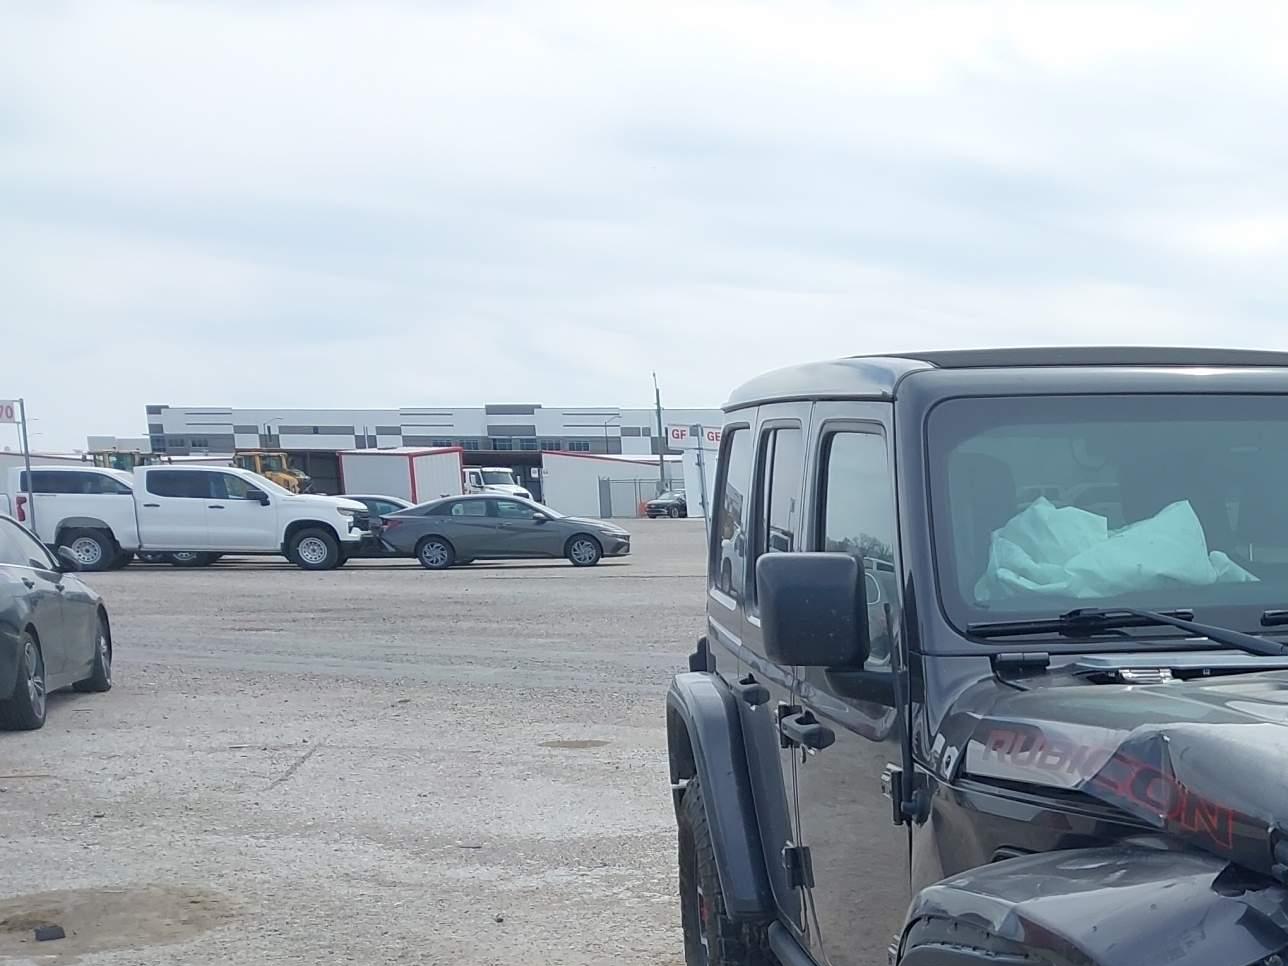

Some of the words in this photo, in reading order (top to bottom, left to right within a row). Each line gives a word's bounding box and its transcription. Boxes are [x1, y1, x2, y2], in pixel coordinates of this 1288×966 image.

[671, 428, 687, 440] GF
[706, 431, 721, 442] GE
[982, 728, 1233, 849] RUBICON
